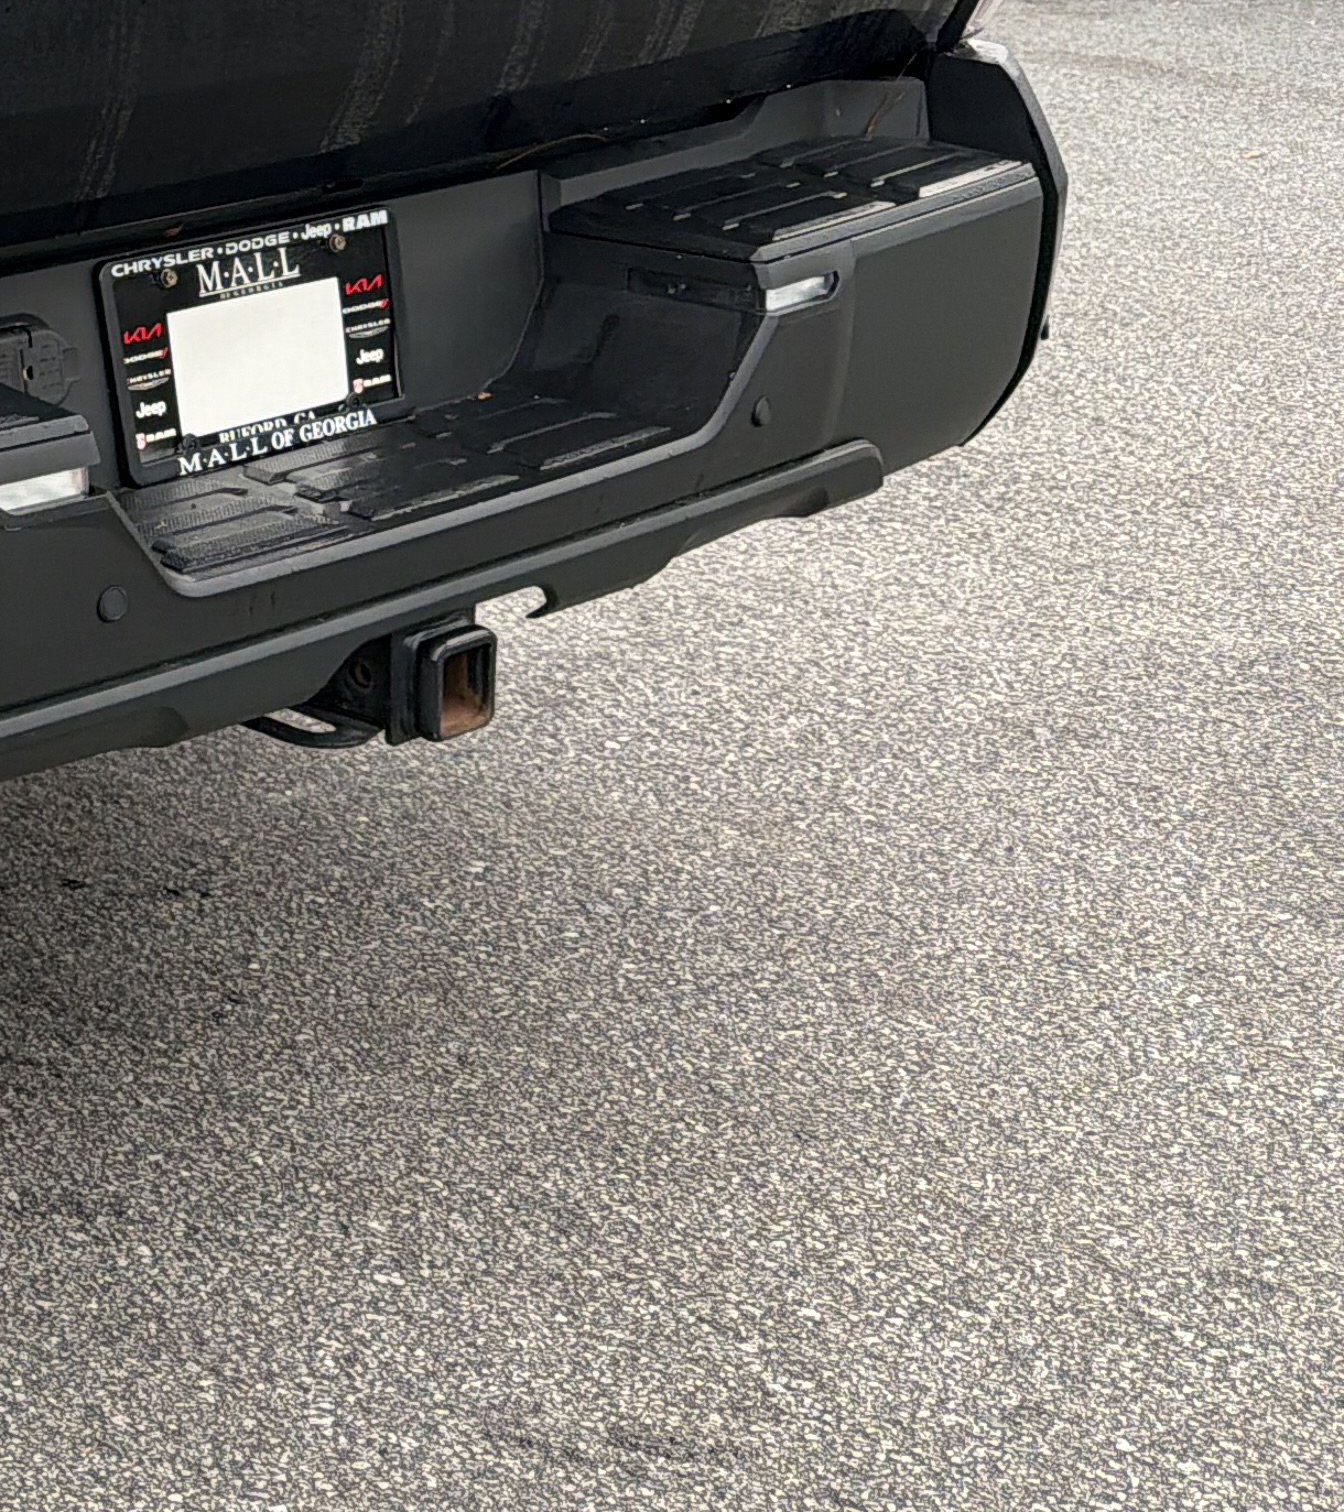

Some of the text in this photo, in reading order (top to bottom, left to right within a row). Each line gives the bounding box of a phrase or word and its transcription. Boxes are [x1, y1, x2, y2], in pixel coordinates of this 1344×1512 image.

[111, 210, 389, 277] CHRYSLER DODGE Jeep RAM
[356, 348, 384, 365] Jeep
[135, 401, 167, 419] Jeep
[271, 429, 295, 450] OF
[299, 408, 377, 442] GEORGIA
